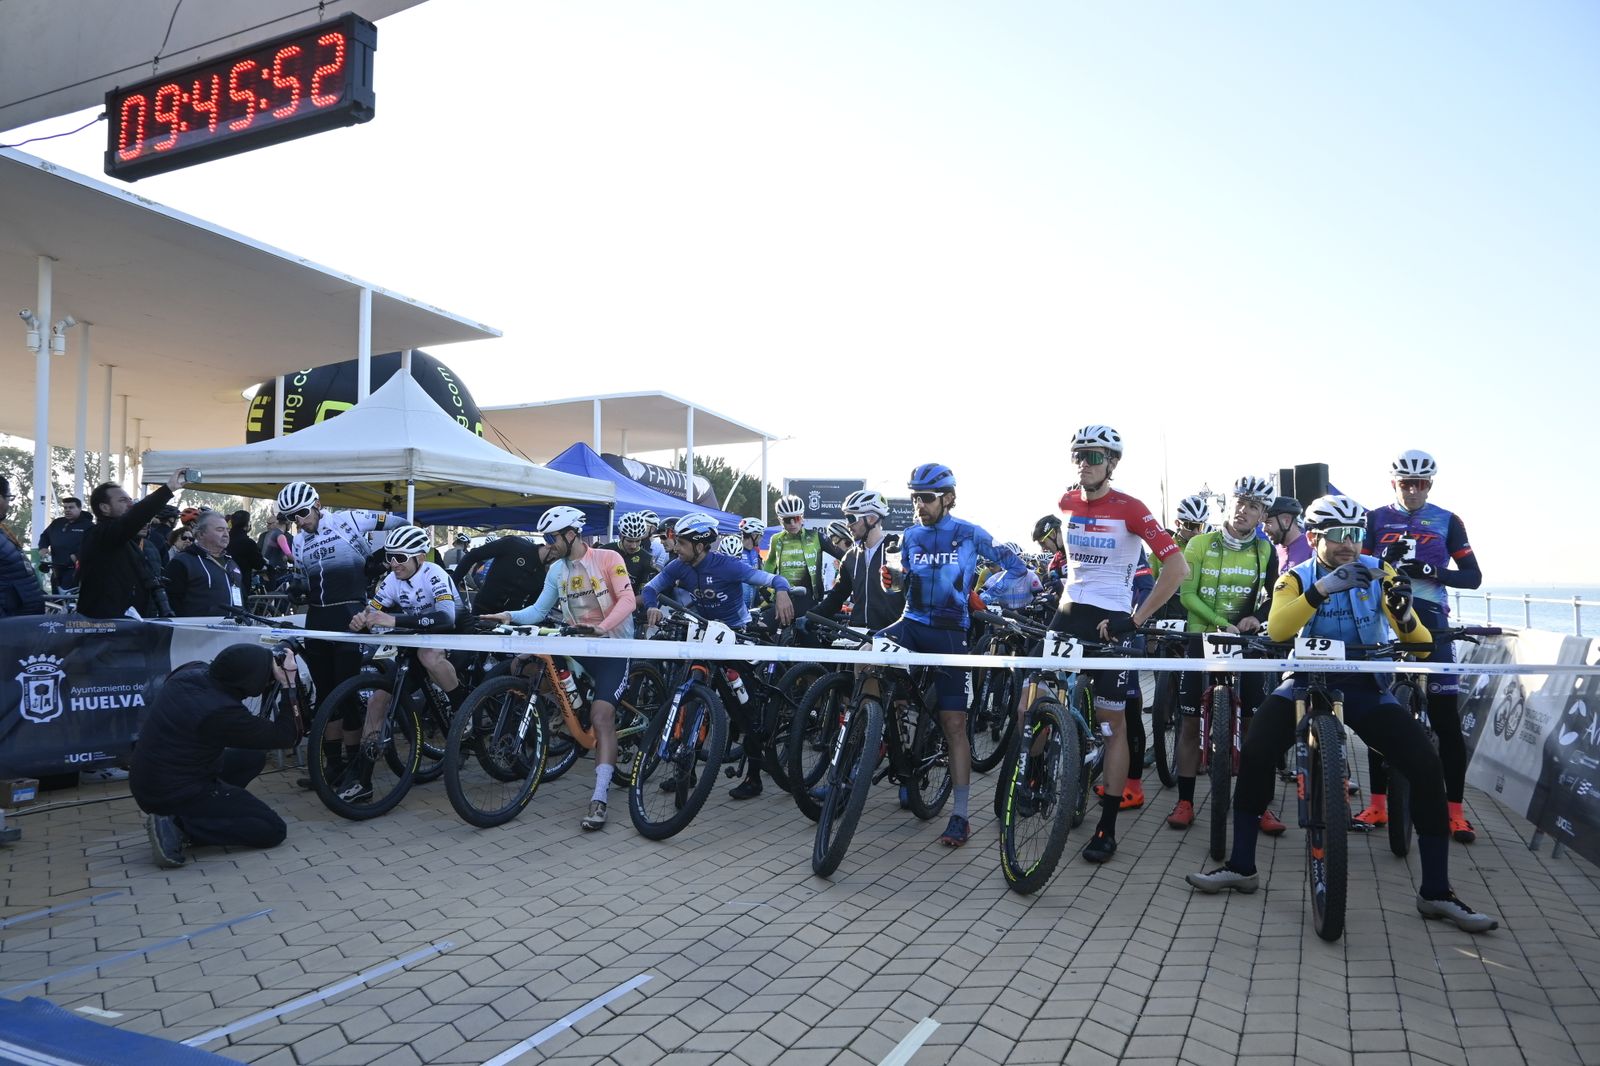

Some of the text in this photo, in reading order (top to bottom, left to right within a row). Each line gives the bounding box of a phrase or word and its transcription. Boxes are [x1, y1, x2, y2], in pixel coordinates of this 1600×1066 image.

[118, 32, 345, 161] 09:45:52
[913, 550, 959, 565] FANTÉ
[715, 631, 726, 645] 4
[1305, 638, 1332, 651] 49
[1050, 640, 1074, 658] 12
[71, 683, 144, 695] Ayuntamiento de
[71, 694, 145, 712] HUELVA
[70, 753, 93, 763] UCI
